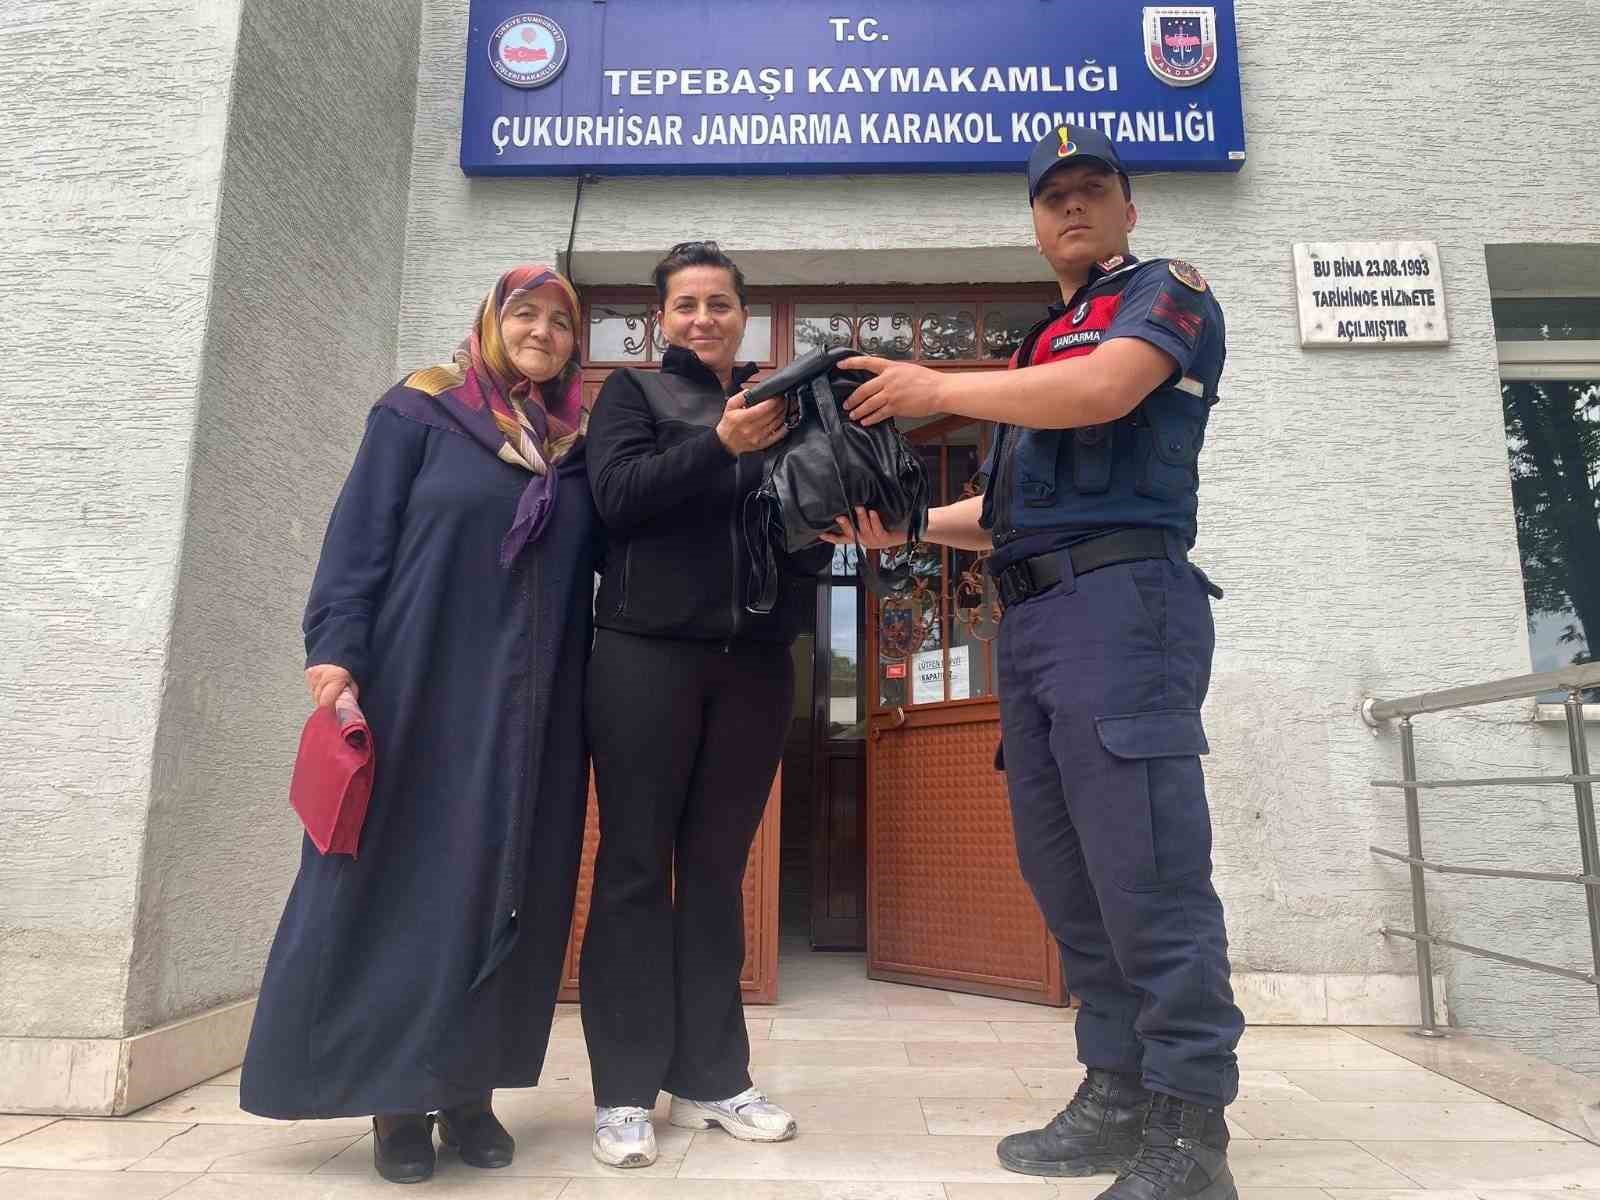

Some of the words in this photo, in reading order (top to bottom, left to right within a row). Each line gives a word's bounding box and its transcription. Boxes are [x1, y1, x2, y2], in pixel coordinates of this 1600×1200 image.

[829, 18, 889, 42] T.C.
[604, 69, 794, 101] TEPEBAŞI
[808, 60, 1119, 93] KAYMAKAMLIĞI
[492, 108, 683, 155] ÇUKURHİSAR
[692, 114, 852, 145] JANDARMA
[860, 113, 1002, 144] KARAKOL
[1313, 260, 1331, 277] BU
[1334, 257, 1363, 277] BİNA
[1366, 259, 1430, 277] 23.08.1993
[1312, 286, 1379, 307] TARİHİNDE
[1054, 331, 1100, 348] JANDARMA
[1337, 320, 1408, 341] AÇILMIŞTIR
